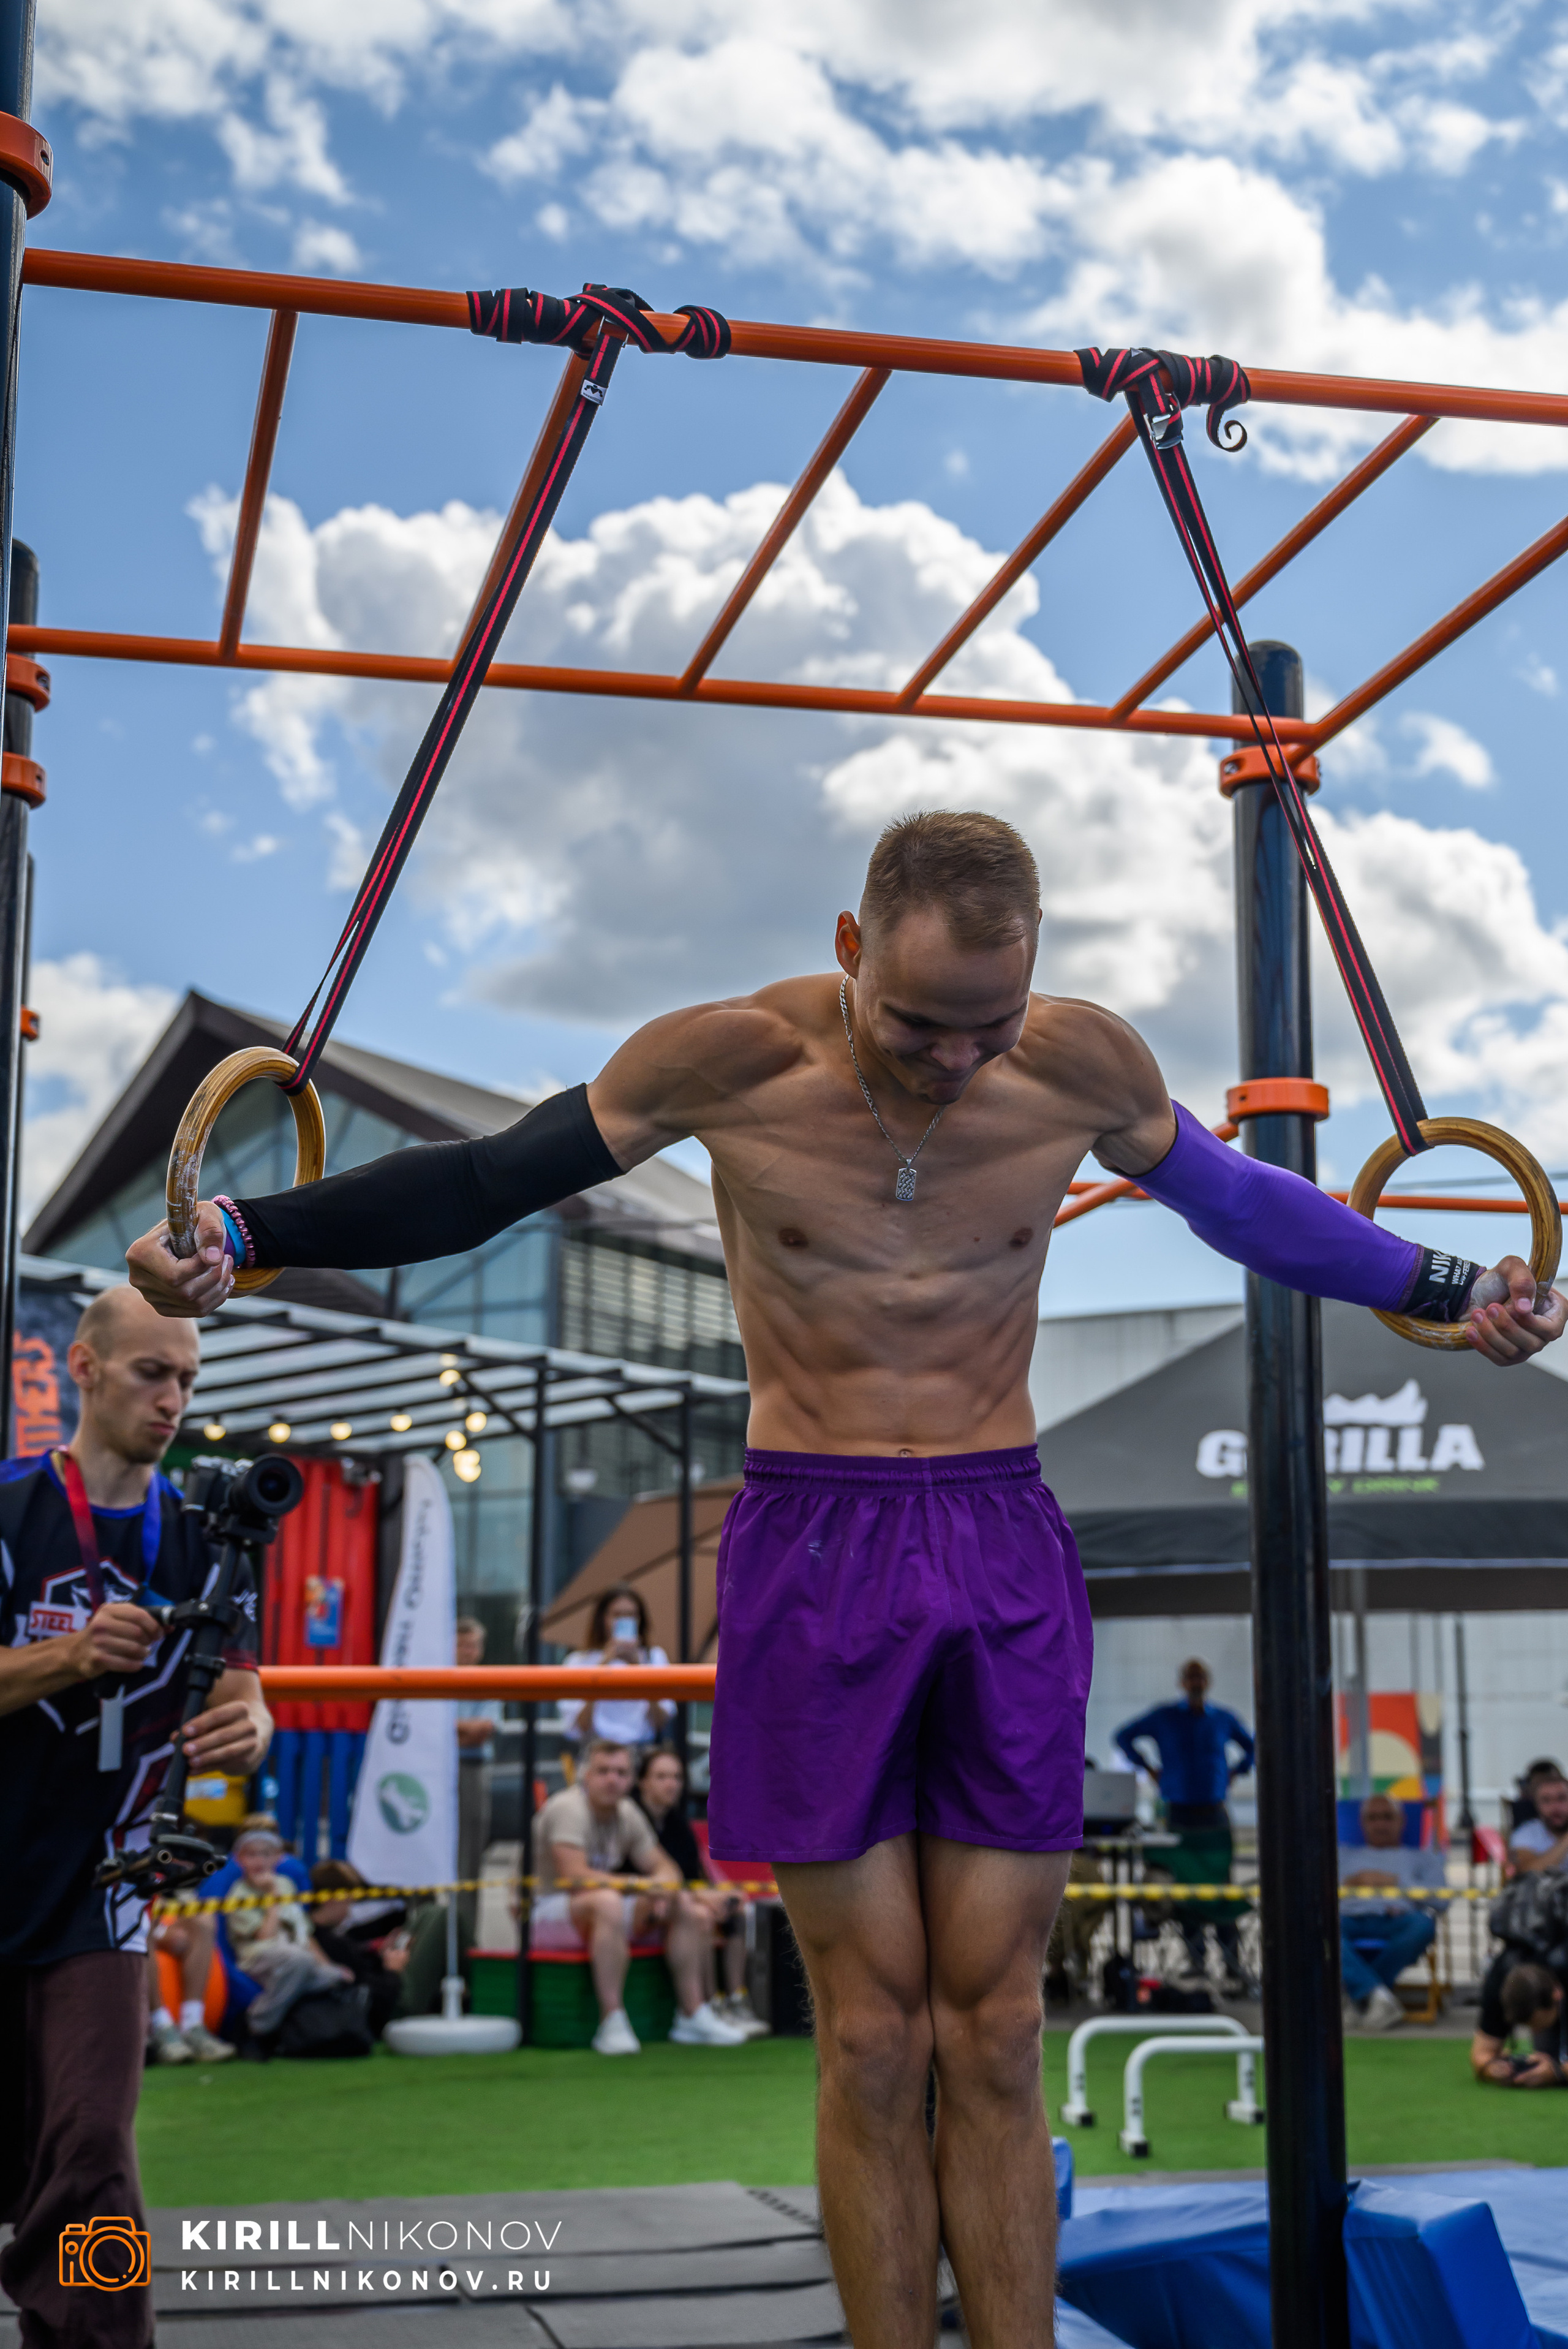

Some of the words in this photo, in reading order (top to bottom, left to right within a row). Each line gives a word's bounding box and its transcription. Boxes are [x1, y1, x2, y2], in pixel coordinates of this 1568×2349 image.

[1428, 1250, 1452, 1284] NIK
[1451, 1265, 1462, 1285] WHAT
[1459, 1260, 1471, 1285] DIFFERE
[1196, 1423, 1485, 1478] GRILLA
[30, 1609, 77, 1633] STEEL
